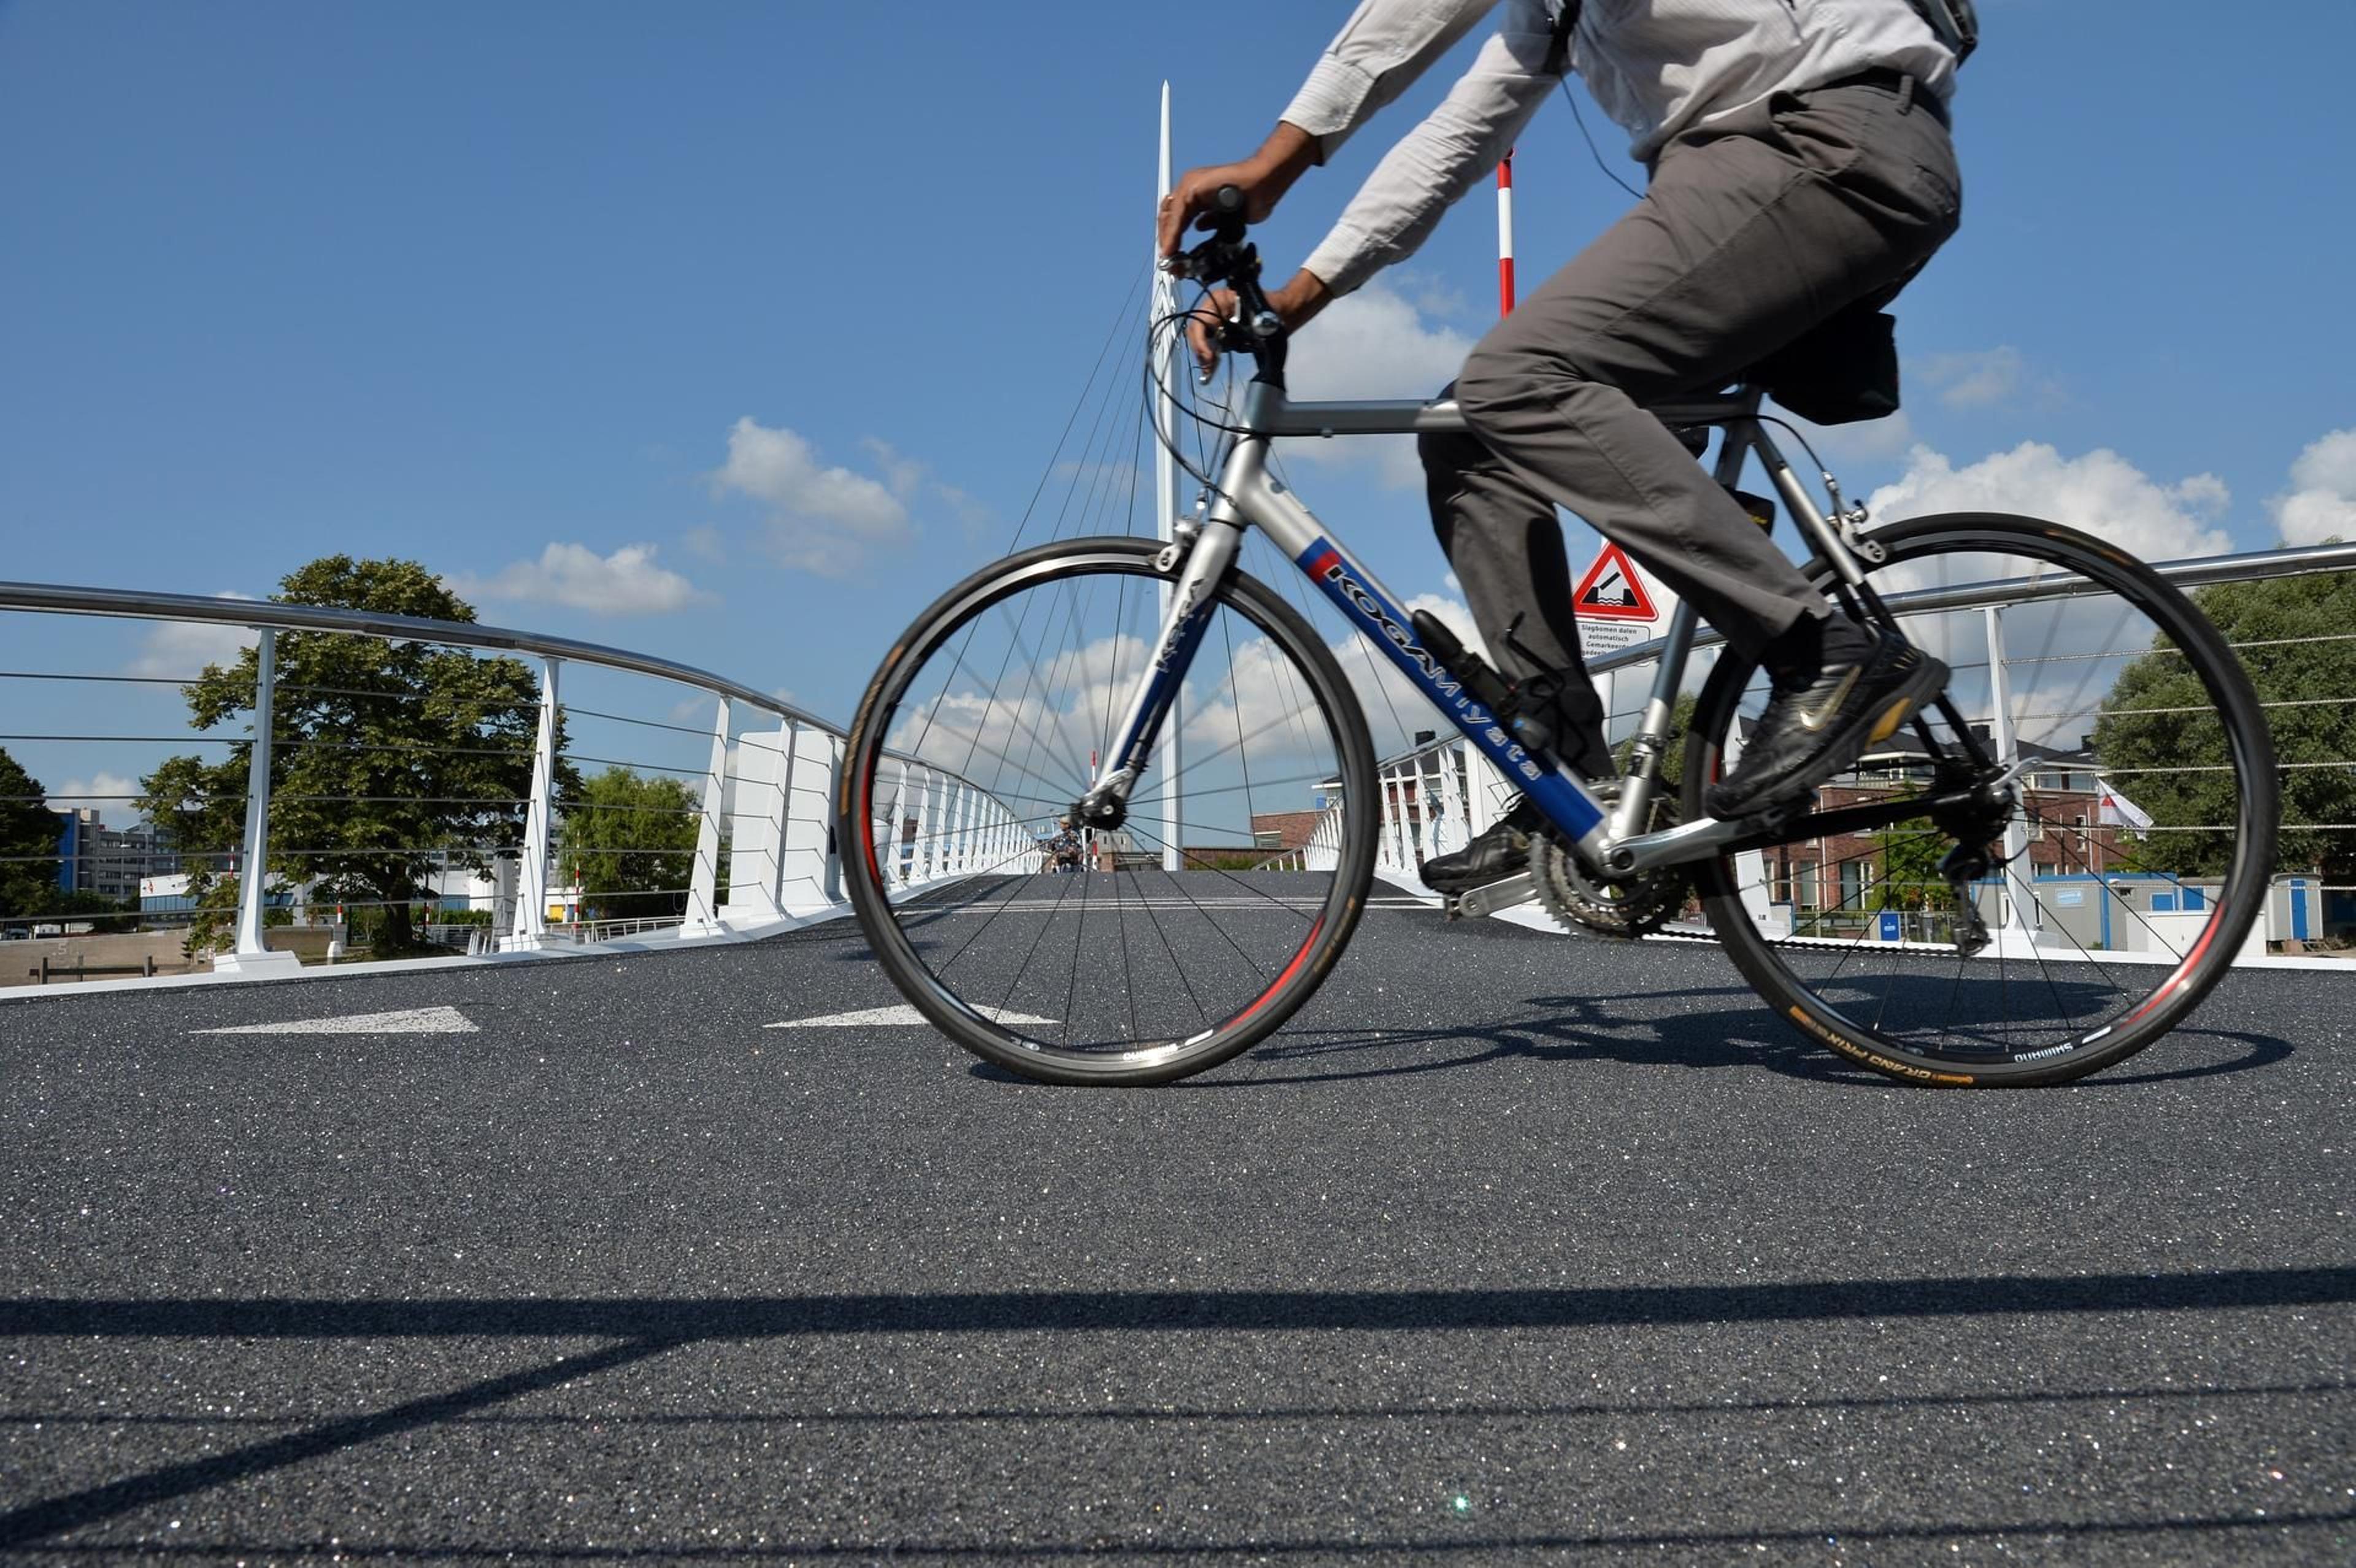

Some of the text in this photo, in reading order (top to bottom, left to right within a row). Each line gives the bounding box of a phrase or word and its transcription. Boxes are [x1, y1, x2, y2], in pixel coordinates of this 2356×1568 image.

[1582, 624, 1617, 632] Slagbomen
[1826, 1034, 1932, 1078] GRAND PRIX
[2014, 1042, 2074, 1063] SHIMANO
